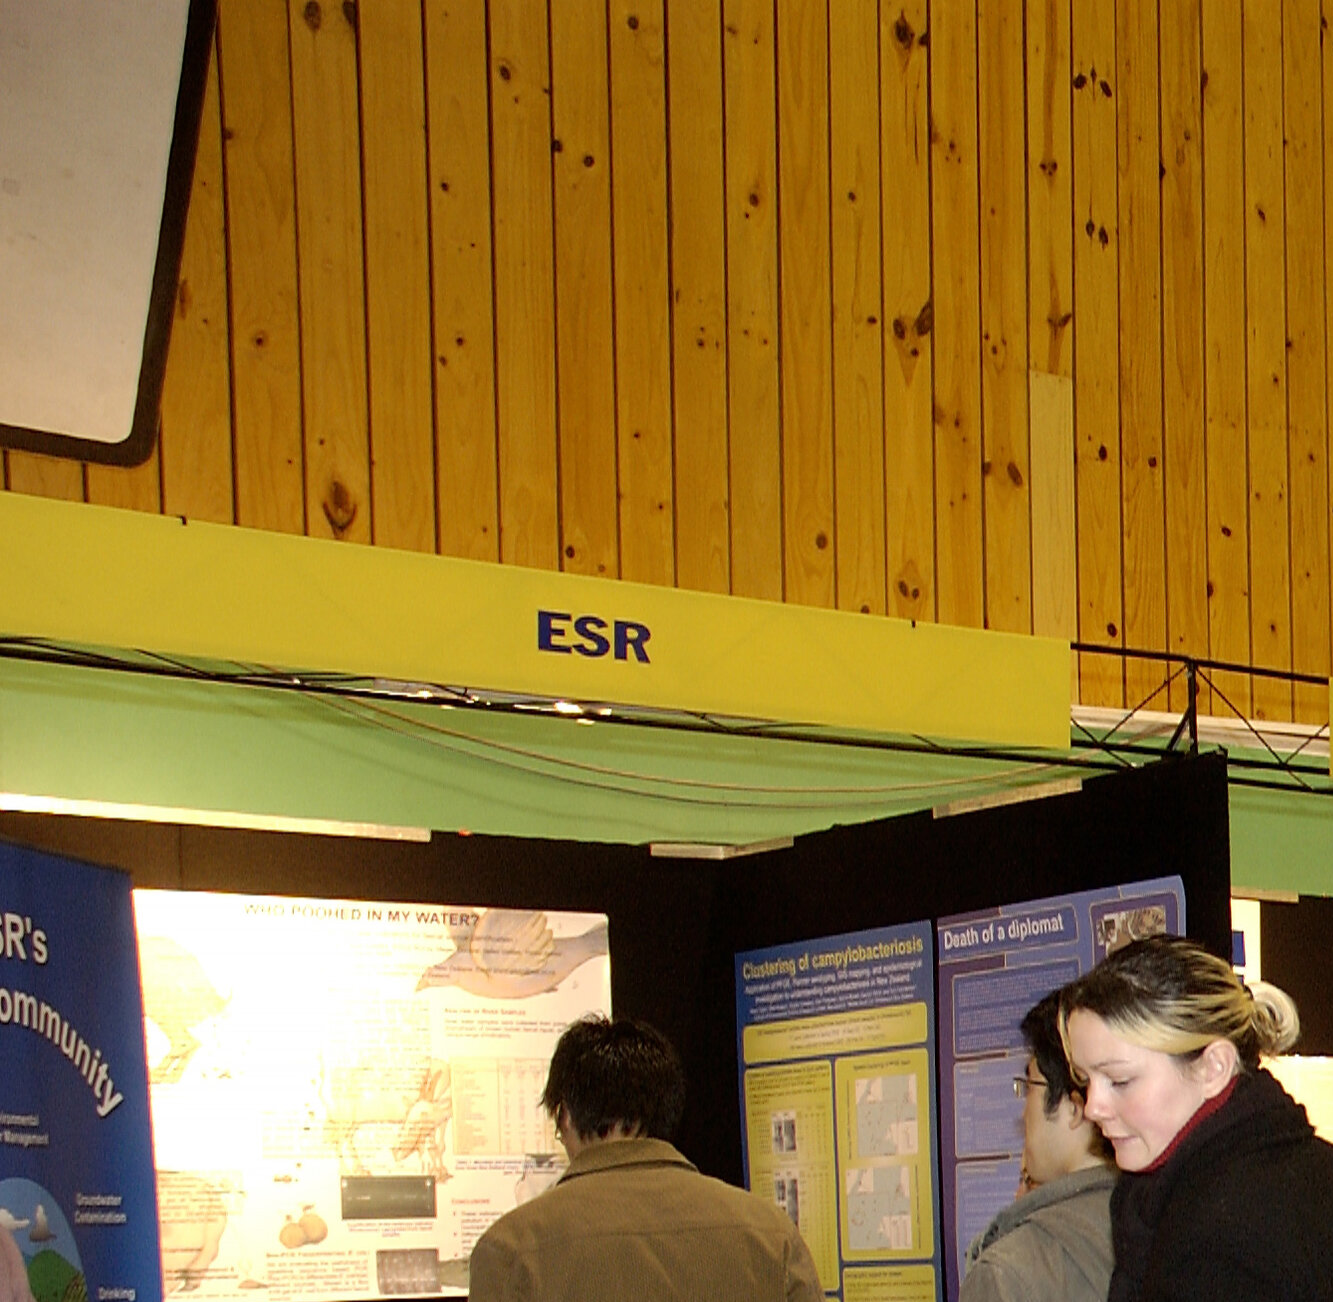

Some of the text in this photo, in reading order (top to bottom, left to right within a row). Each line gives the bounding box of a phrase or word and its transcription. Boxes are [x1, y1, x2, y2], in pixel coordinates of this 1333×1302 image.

[537, 610, 651, 664] ESR
[0, 912, 48, 964] R's
[367, 909, 383, 922] IN
[388, 910, 411, 923] MY
[416, 912, 480, 927] WATER?
[944, 913, 1065, 950] Death of a diplomat
[742, 958, 796, 980] Clustering
[799, 953, 809, 971] of
[812, 935, 924, 968] campylobacteriosis
[0, 987, 124, 1117] ommunity
